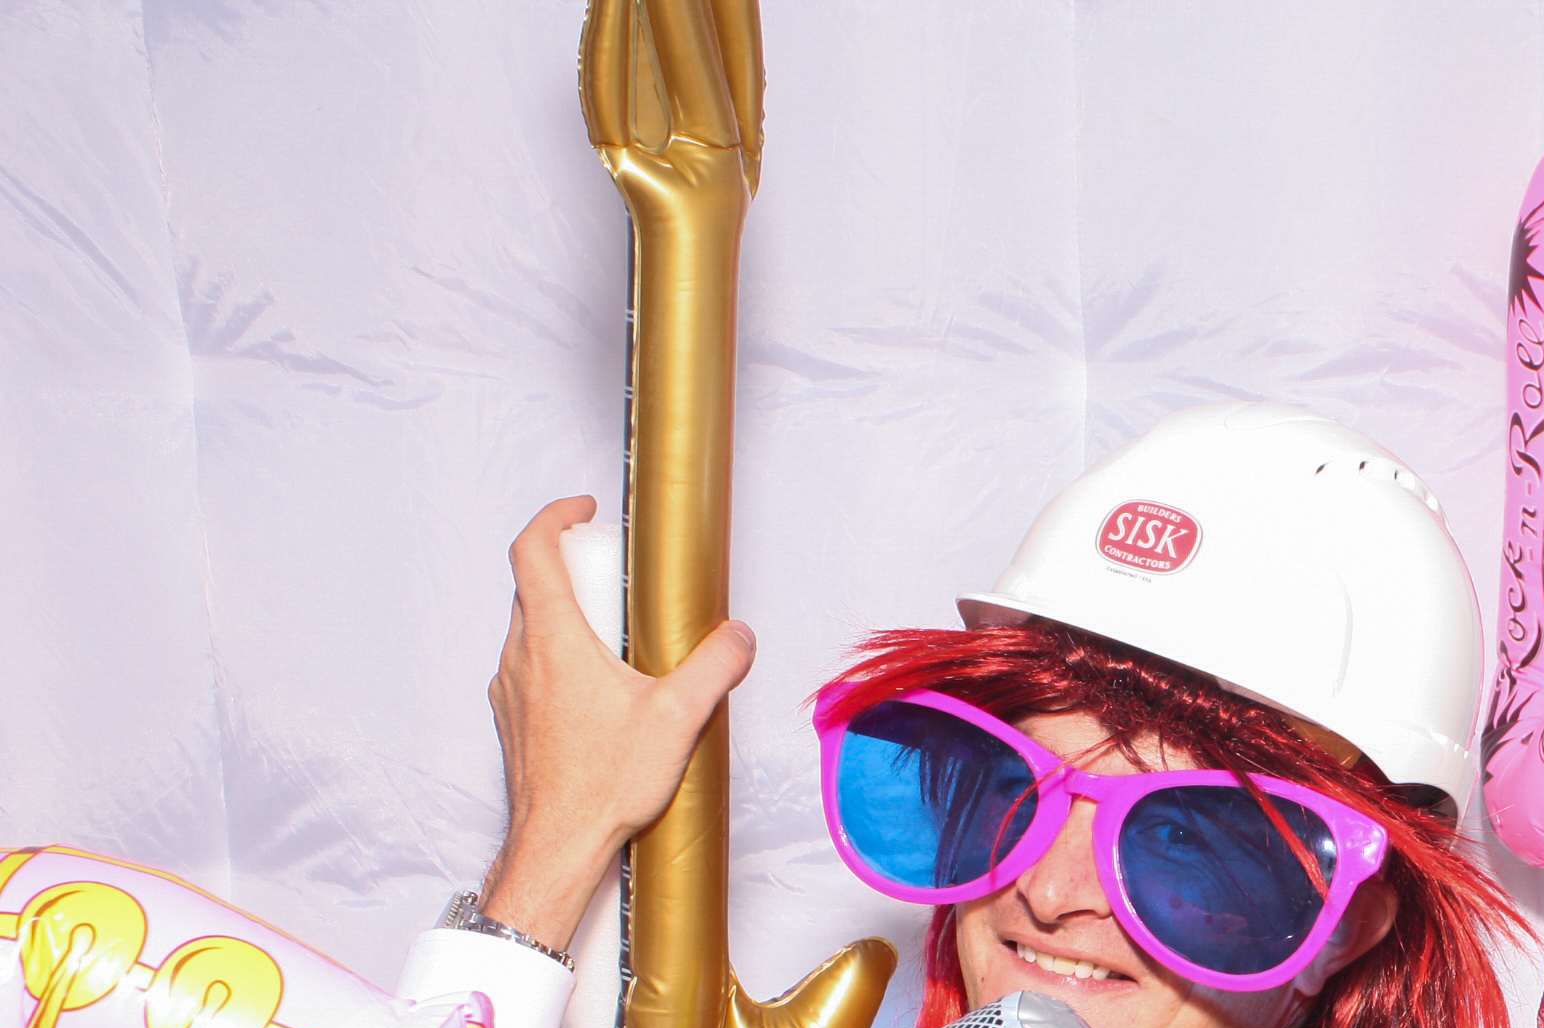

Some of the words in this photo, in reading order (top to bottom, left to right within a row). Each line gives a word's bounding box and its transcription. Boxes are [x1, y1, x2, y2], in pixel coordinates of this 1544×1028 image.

[1137, 504, 1182, 523] BUILDERS
[1108, 512, 1189, 558] SISK
[1104, 545, 1171, 570] CONTRACTORS
